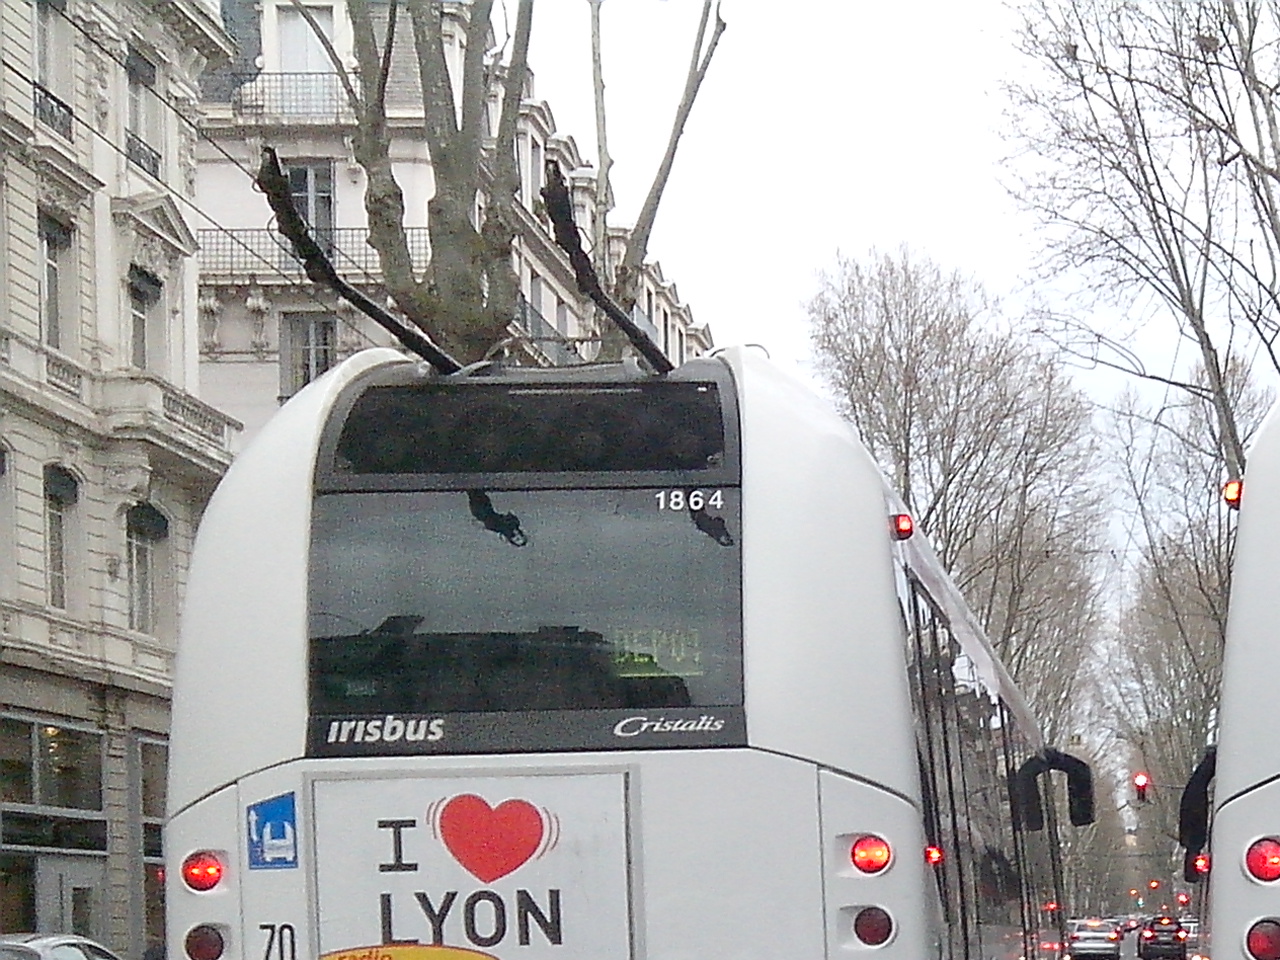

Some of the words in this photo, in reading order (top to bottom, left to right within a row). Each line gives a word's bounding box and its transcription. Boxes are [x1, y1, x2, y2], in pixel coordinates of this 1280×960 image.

[655, 490, 724, 510] 1864
[613, 716, 725, 737] Cristalis
[377, 819, 418, 872] I
[380, 888, 563, 948] LYON
